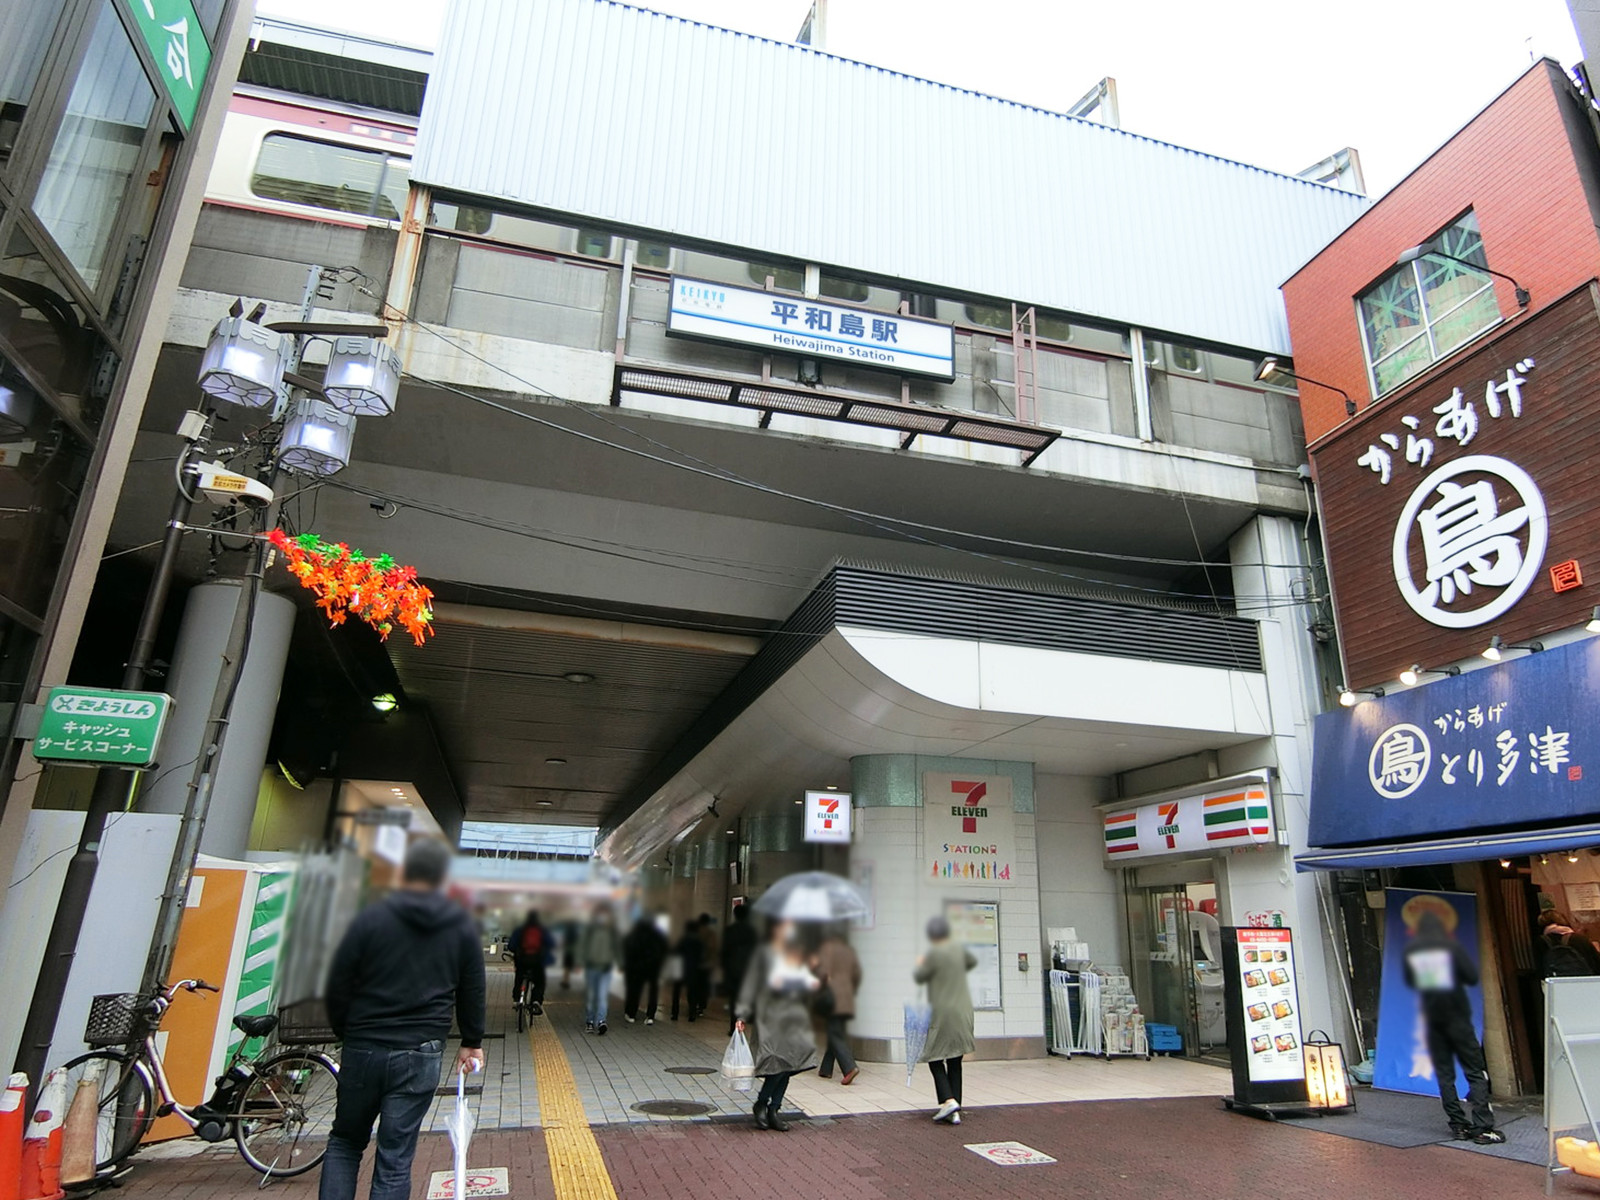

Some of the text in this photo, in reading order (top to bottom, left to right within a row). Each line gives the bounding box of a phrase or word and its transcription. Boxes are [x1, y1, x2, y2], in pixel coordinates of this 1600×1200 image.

[680, 285, 726, 303] KEIKYU
[771, 300, 898, 344] 平和島駅
[773, 333, 895, 363] Heiwajima Station
[1357, 357, 1535, 485] からあげ
[1416, 480, 1531, 606] 鳥
[63, 721, 131, 737] キャッシュ
[1434, 702, 1507, 734] からあげ
[39, 738, 148, 754] サービスコーナー
[1378, 732, 1425, 788] 鳥
[1441, 725, 1570, 787] とり多津
[943, 843, 989, 854] STATION
